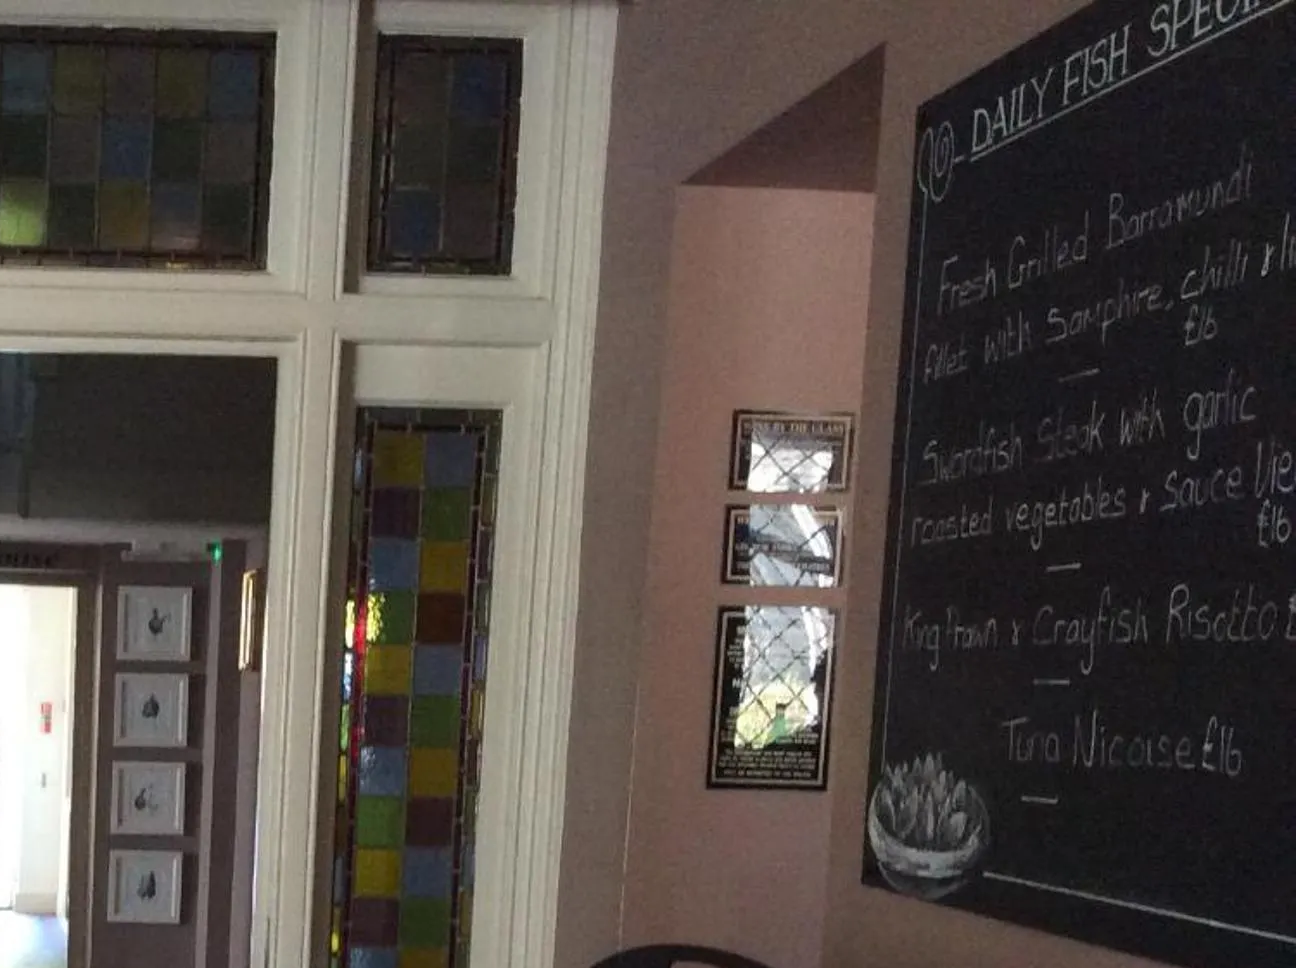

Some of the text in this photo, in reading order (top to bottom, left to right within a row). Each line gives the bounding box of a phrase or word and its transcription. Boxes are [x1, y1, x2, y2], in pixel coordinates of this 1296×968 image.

[971, 0, 1260, 154] DAILY FISH SPE
[937, 254, 997, 316] Fresh
[1008, 209, 1091, 290] Grilled
[984, 309, 1032, 366] with
[918, 421, 1022, 486] Swordfish
[1119, 388, 1166, 447] with
[1182, 367, 1258, 462] garlic
[1006, 473, 1127, 552] vegetables
[1256, 498, 1294, 549] £16
